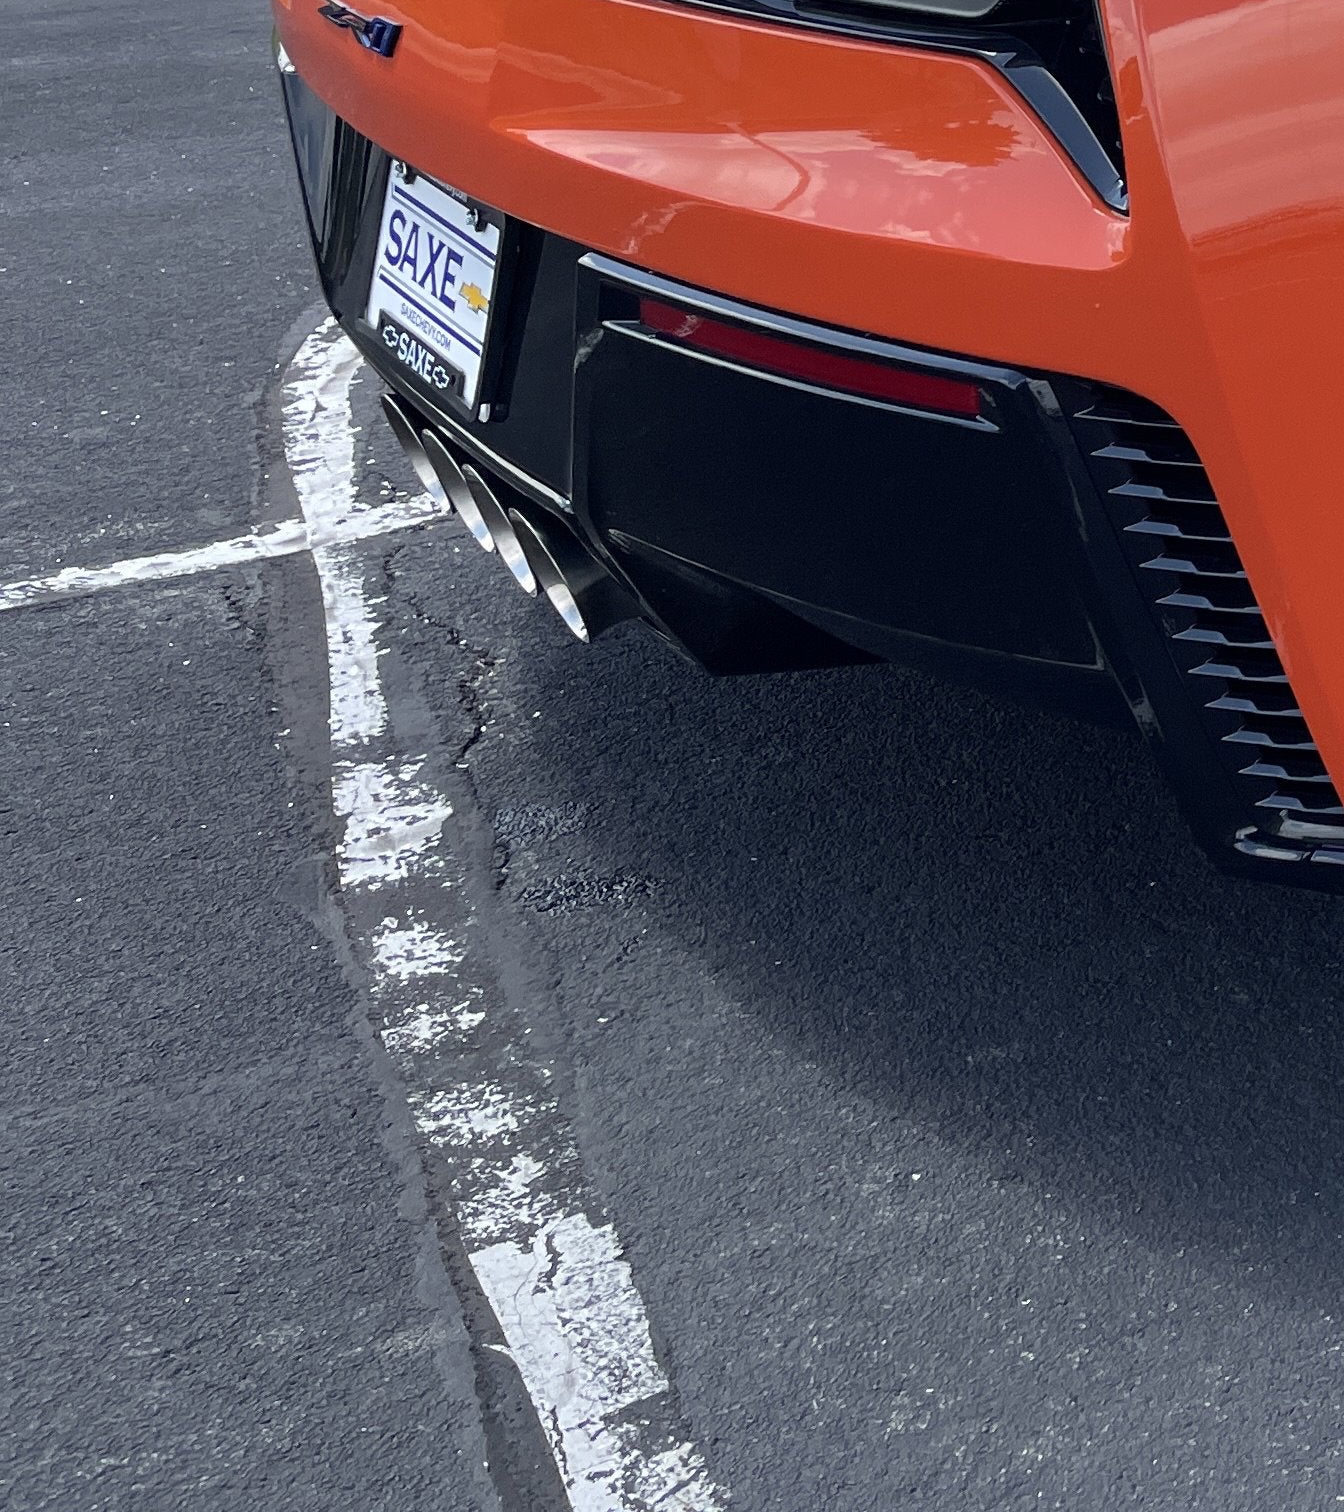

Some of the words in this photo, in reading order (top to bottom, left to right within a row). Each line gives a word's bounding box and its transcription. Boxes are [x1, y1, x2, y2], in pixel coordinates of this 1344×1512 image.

[384, 209, 464, 312] SAXE
[401, 303, 452, 351] SAXECHEVY.COM
[397, 333, 435, 384] SAXE
